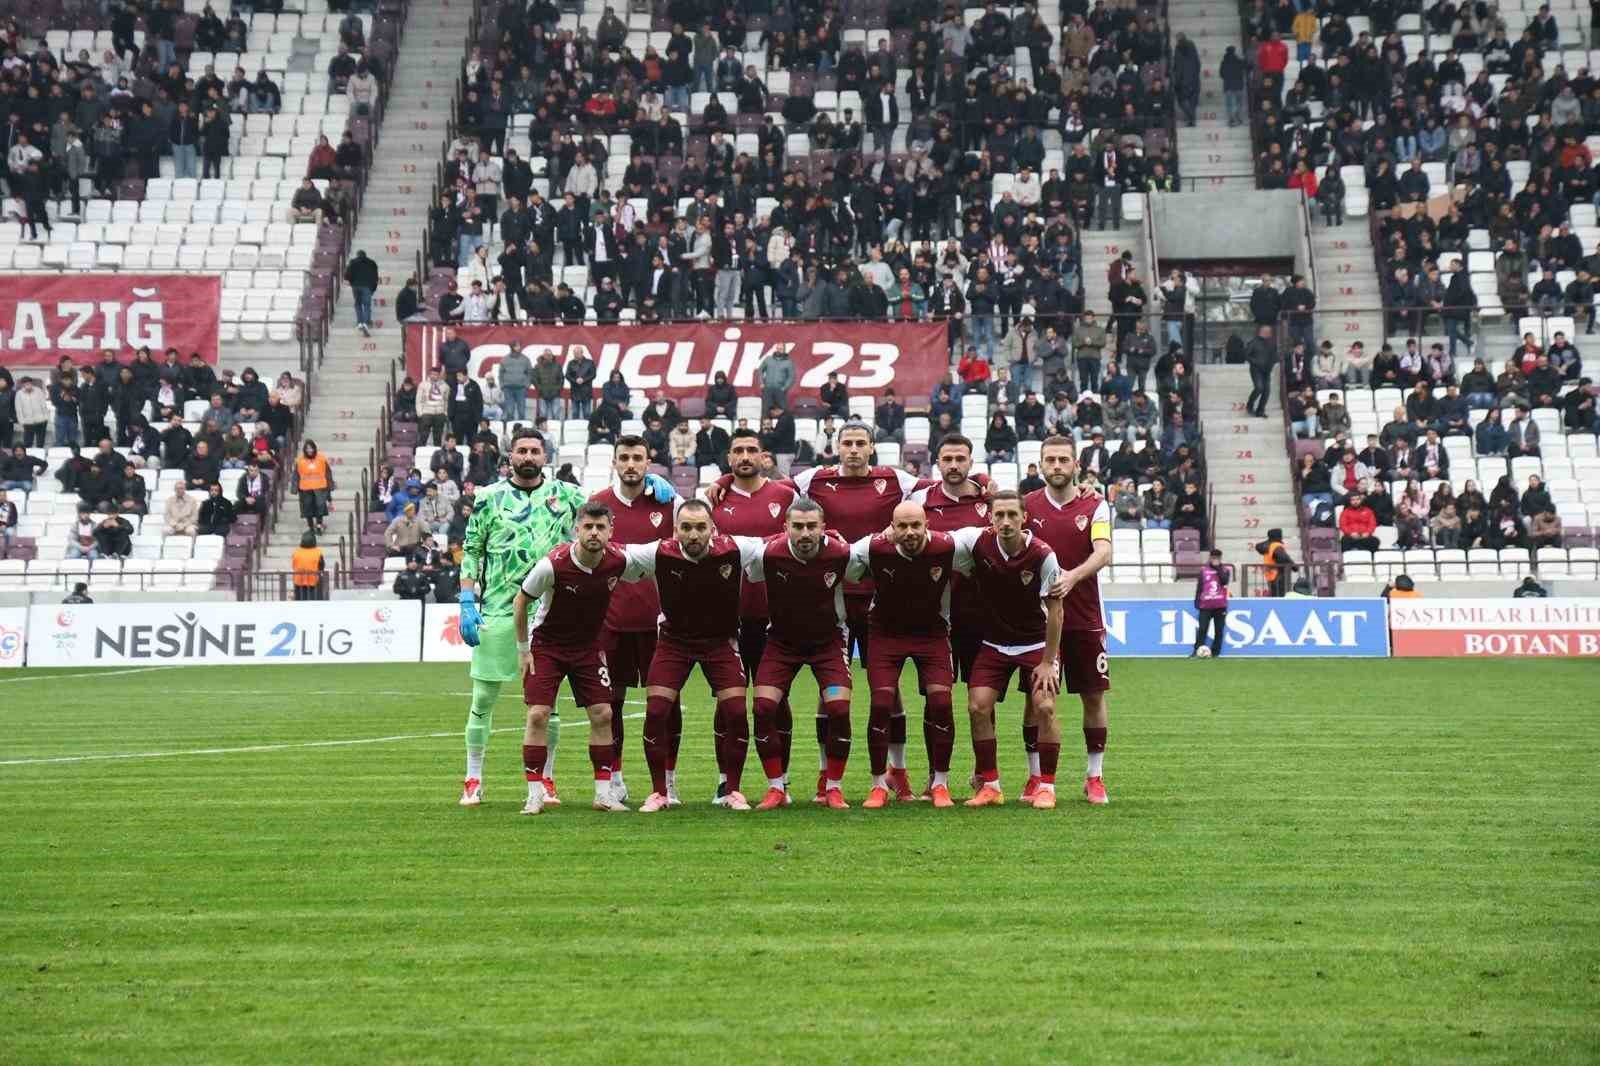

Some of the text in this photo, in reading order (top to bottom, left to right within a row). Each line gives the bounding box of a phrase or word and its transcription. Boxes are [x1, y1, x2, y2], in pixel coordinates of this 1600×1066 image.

[1104, 245, 1119, 255] 16
[0, 287, 163, 349] AZIĞ
[1344, 322, 1360, 331] 20
[801, 342, 900, 388] 23
[1233, 425, 1248, 434] 23
[1235, 450, 1252, 459] 24
[1239, 474, 1255, 484] 25
[1241, 496, 1257, 505] 26
[1244, 518, 1260, 528] 27
[1463, 633, 1600, 655] BOTAN B
[1096, 652, 1108, 673] 6
[598, 666, 611, 687] 3
